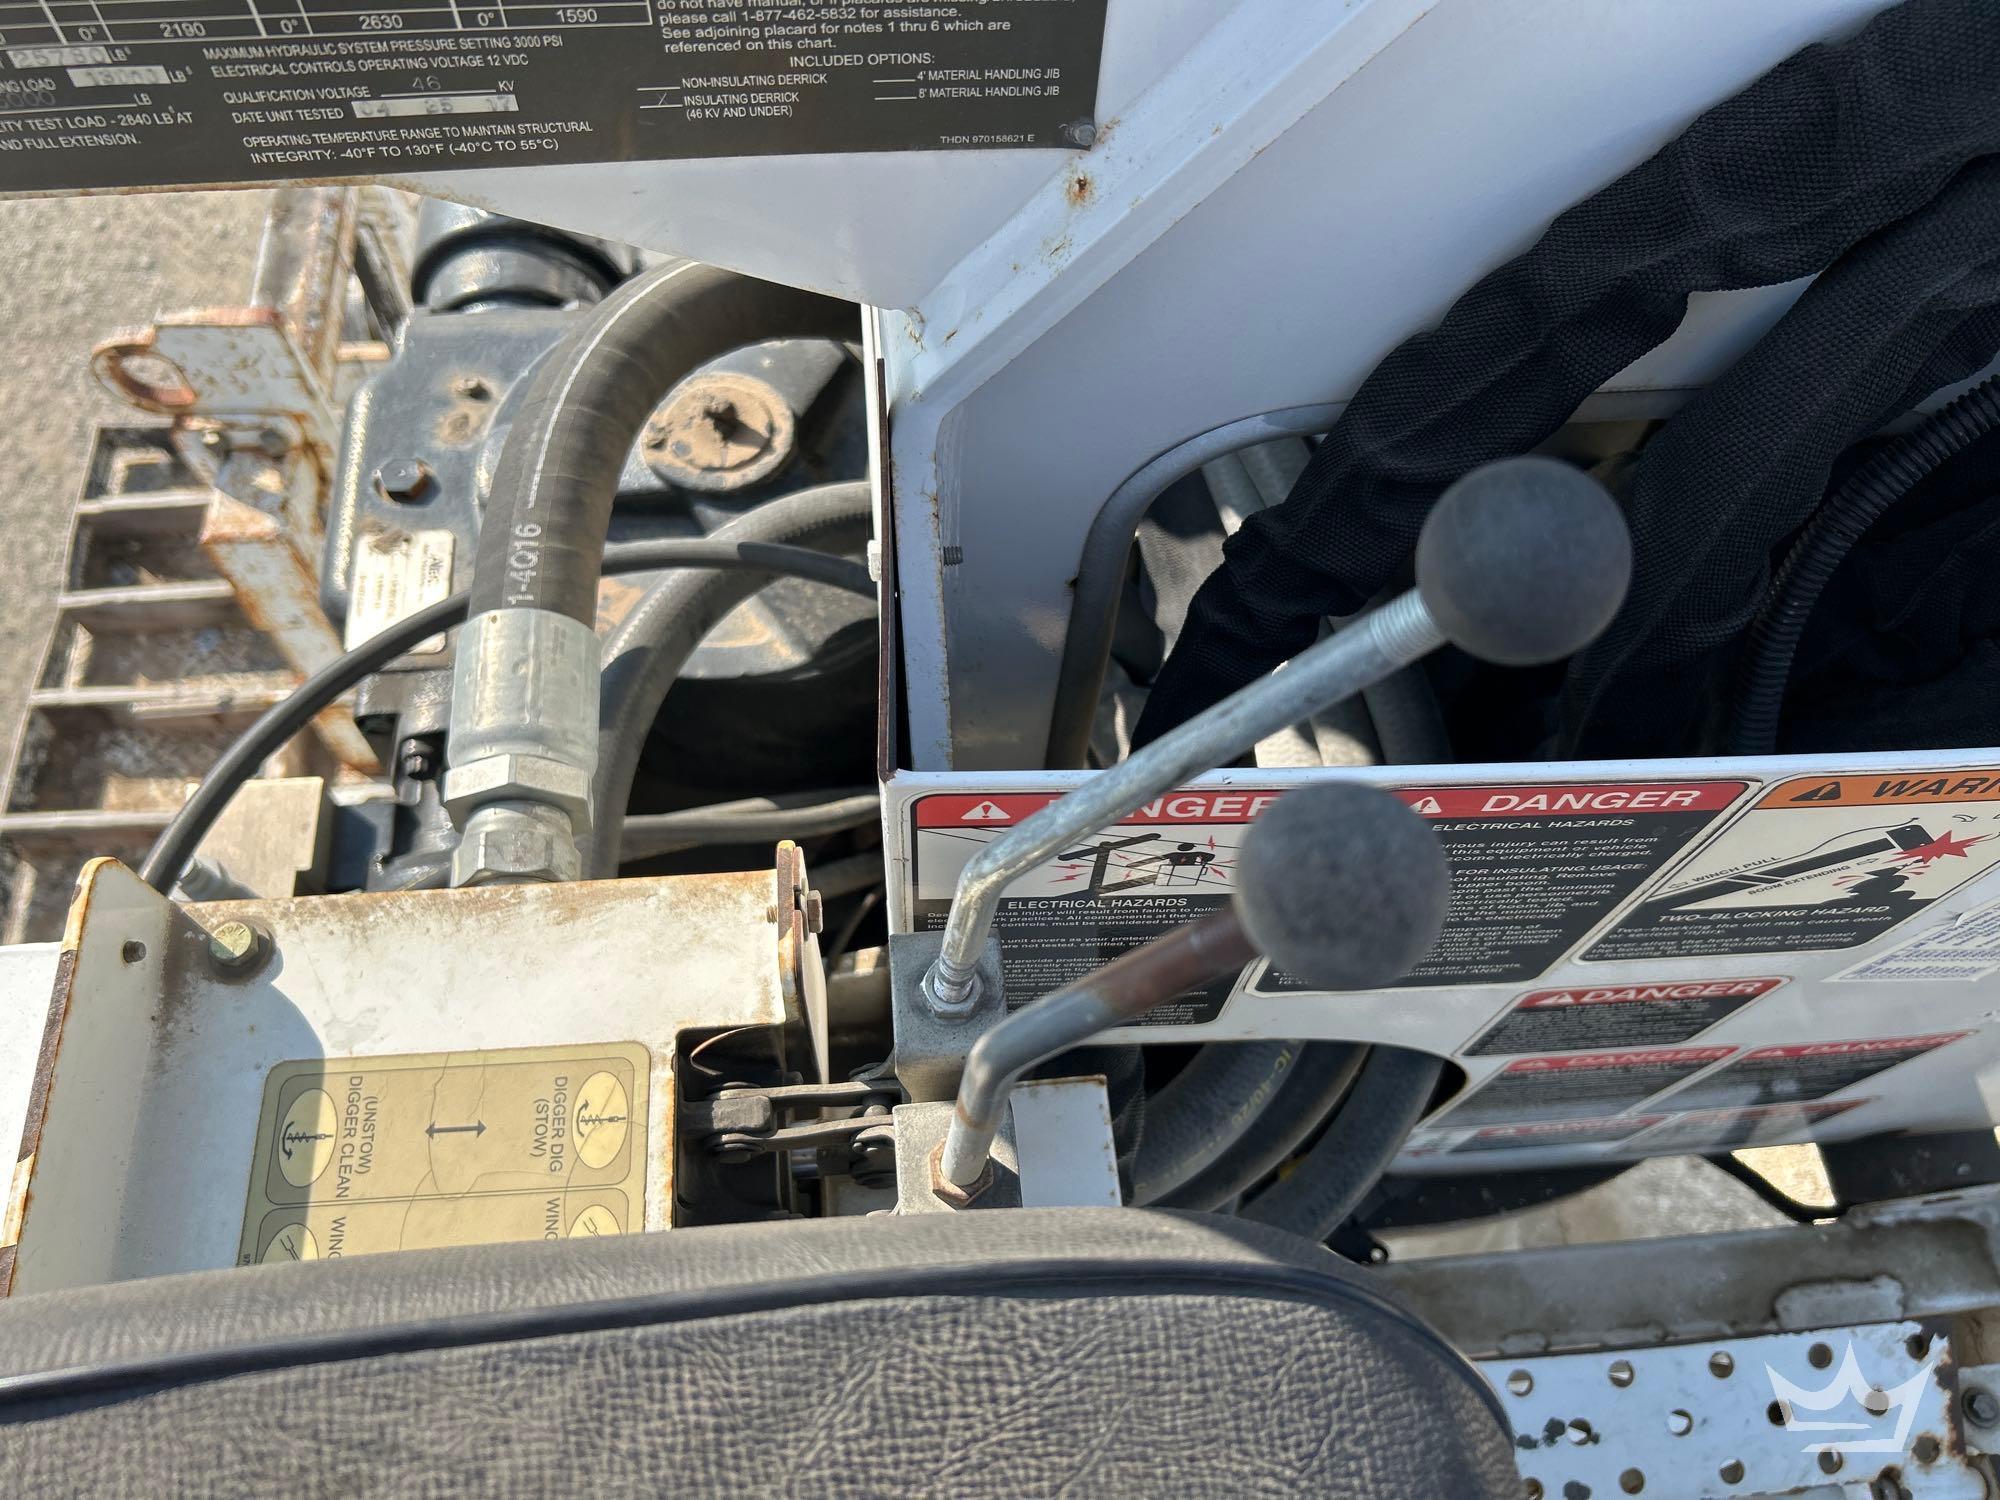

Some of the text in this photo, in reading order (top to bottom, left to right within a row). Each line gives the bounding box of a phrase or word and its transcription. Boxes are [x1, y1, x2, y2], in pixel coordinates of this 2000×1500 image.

[359, 15, 403, 30] 2630
[556, 8, 598, 23] 1590
[660, 7, 962, 26] please call 1-877-462-5832 for assistance.
[662, 20, 1011, 40] See adjoining placard for notes 1 thru 6 which are
[203, 35, 564, 60] MAXIMUM HYDRAULIC SYSTEM PRESSURE SETTING 3000 PSI
[664, 38, 836, 53] referenced on this chart.
[211, 54, 529, 78] ELECTRICAL CONTROLS OPERATING VOLTAGE 12 VDC
[790, 53, 935, 68] INCLUDED OPTIONS:
[682, 73, 828, 89] NON-INSULATING DERRICK
[928, 69, 982, 81] MATERIAL
[985, 68, 1041, 80] HANDLING
[1044, 68, 1060, 79] JIB
[223, 86, 371, 104] QUALIFICATION VOLTAGE
[498, 80, 514, 92] KV
[929, 87, 982, 99] MATERIAL
[985, 86, 1041, 98] HANDLING
[1044, 86, 1060, 96] JIB
[684, 92, 799, 107] INSULATING DERRICK
[26, 117, 63, 131] TEST
[64, 115, 107, 129] LOAD
[117, 113, 151, 127] 2840
[177, 112, 193, 124] AT
[232, 107, 344, 124] DATE UNIT TESTED
[686, 105, 793, 121] (46 KV AND UNDER)
[23, 133, 142, 150] FULL EXTENSION.
[242, 121, 593, 148] OPERATING TEMPERATURE RANGE TO MAINTAIN STRUCTURAL
[940, 135, 970, 144] THDN
[251, 137, 560, 164] INTEGRITY: -40°F TO 130°F (-40°C TO 55°C)
[1480, 790, 1702, 812] DANGER
[1432, 819, 1635, 831] ELECTRICAL HAZARDS
[1486, 847, 1567, 855] equipment
[1493, 866, 1586, 874] INSULATING
[1590, 863, 1648, 871] USAGE:
[1693, 856, 1782, 883] WINCH PULL
[1748, 865, 1851, 895] BOOM EXTENDING
[1008, 898, 1188, 909] ELECTRICAL HAZARDS
[1658, 905, 1890, 922] TWO-BLOCKING HAZARD
[1581, 981, 1763, 1002] DANGER
[1801, 1034, 1961, 1055] DANGER
[1568, 1047, 1730, 1065] DANGER
[529, 1098, 549, 1157] (STOW)
[550, 1076, 568, 1172] DIGGER DIG
[336, 1076, 363, 1198] DIGGER CLEAN
[354, 1096, 378, 1175] (UNSTOW)
[545, 1197, 560, 1241] WINC
[328, 1216, 347, 1259] WINC
